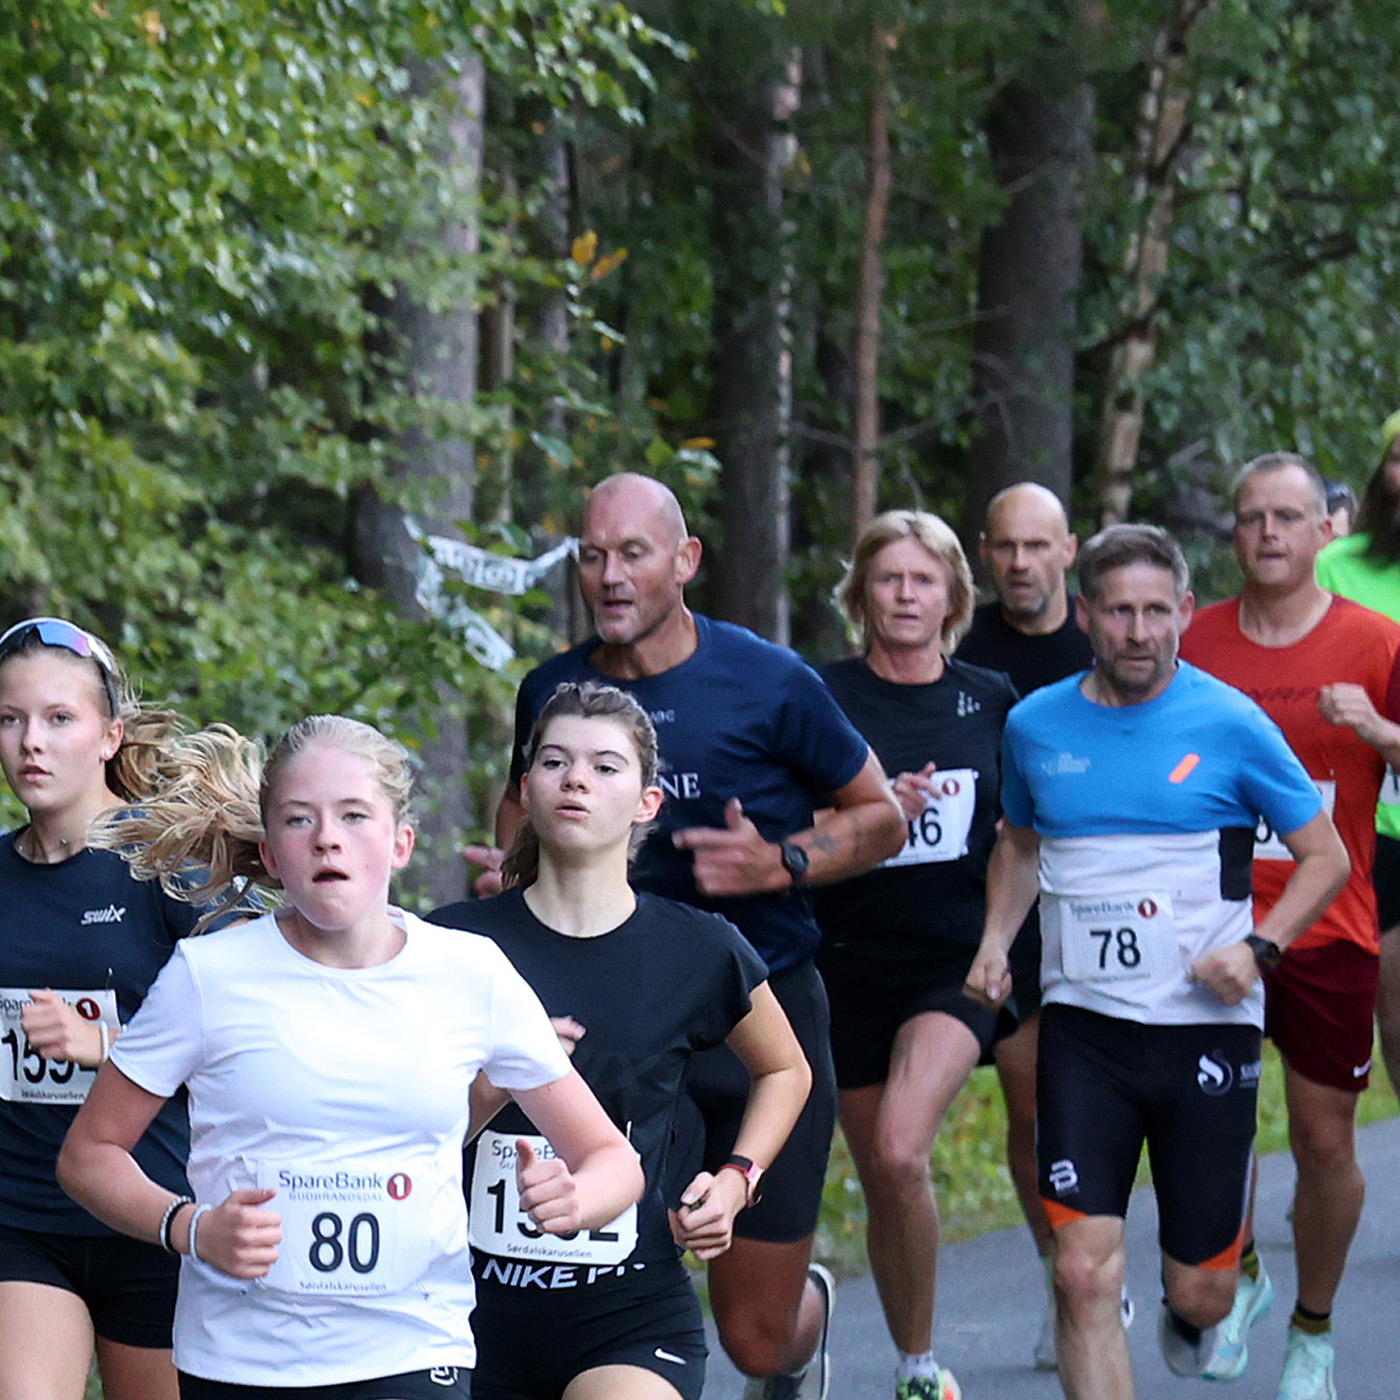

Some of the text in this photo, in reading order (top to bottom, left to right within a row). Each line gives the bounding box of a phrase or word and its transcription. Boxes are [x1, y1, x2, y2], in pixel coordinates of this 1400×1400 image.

[1089, 926, 1142, 970] 78
[279, 1170, 383, 1191] SpareBank
[308, 1211, 380, 1274] 80
[482, 1257, 578, 1290] NIKE
